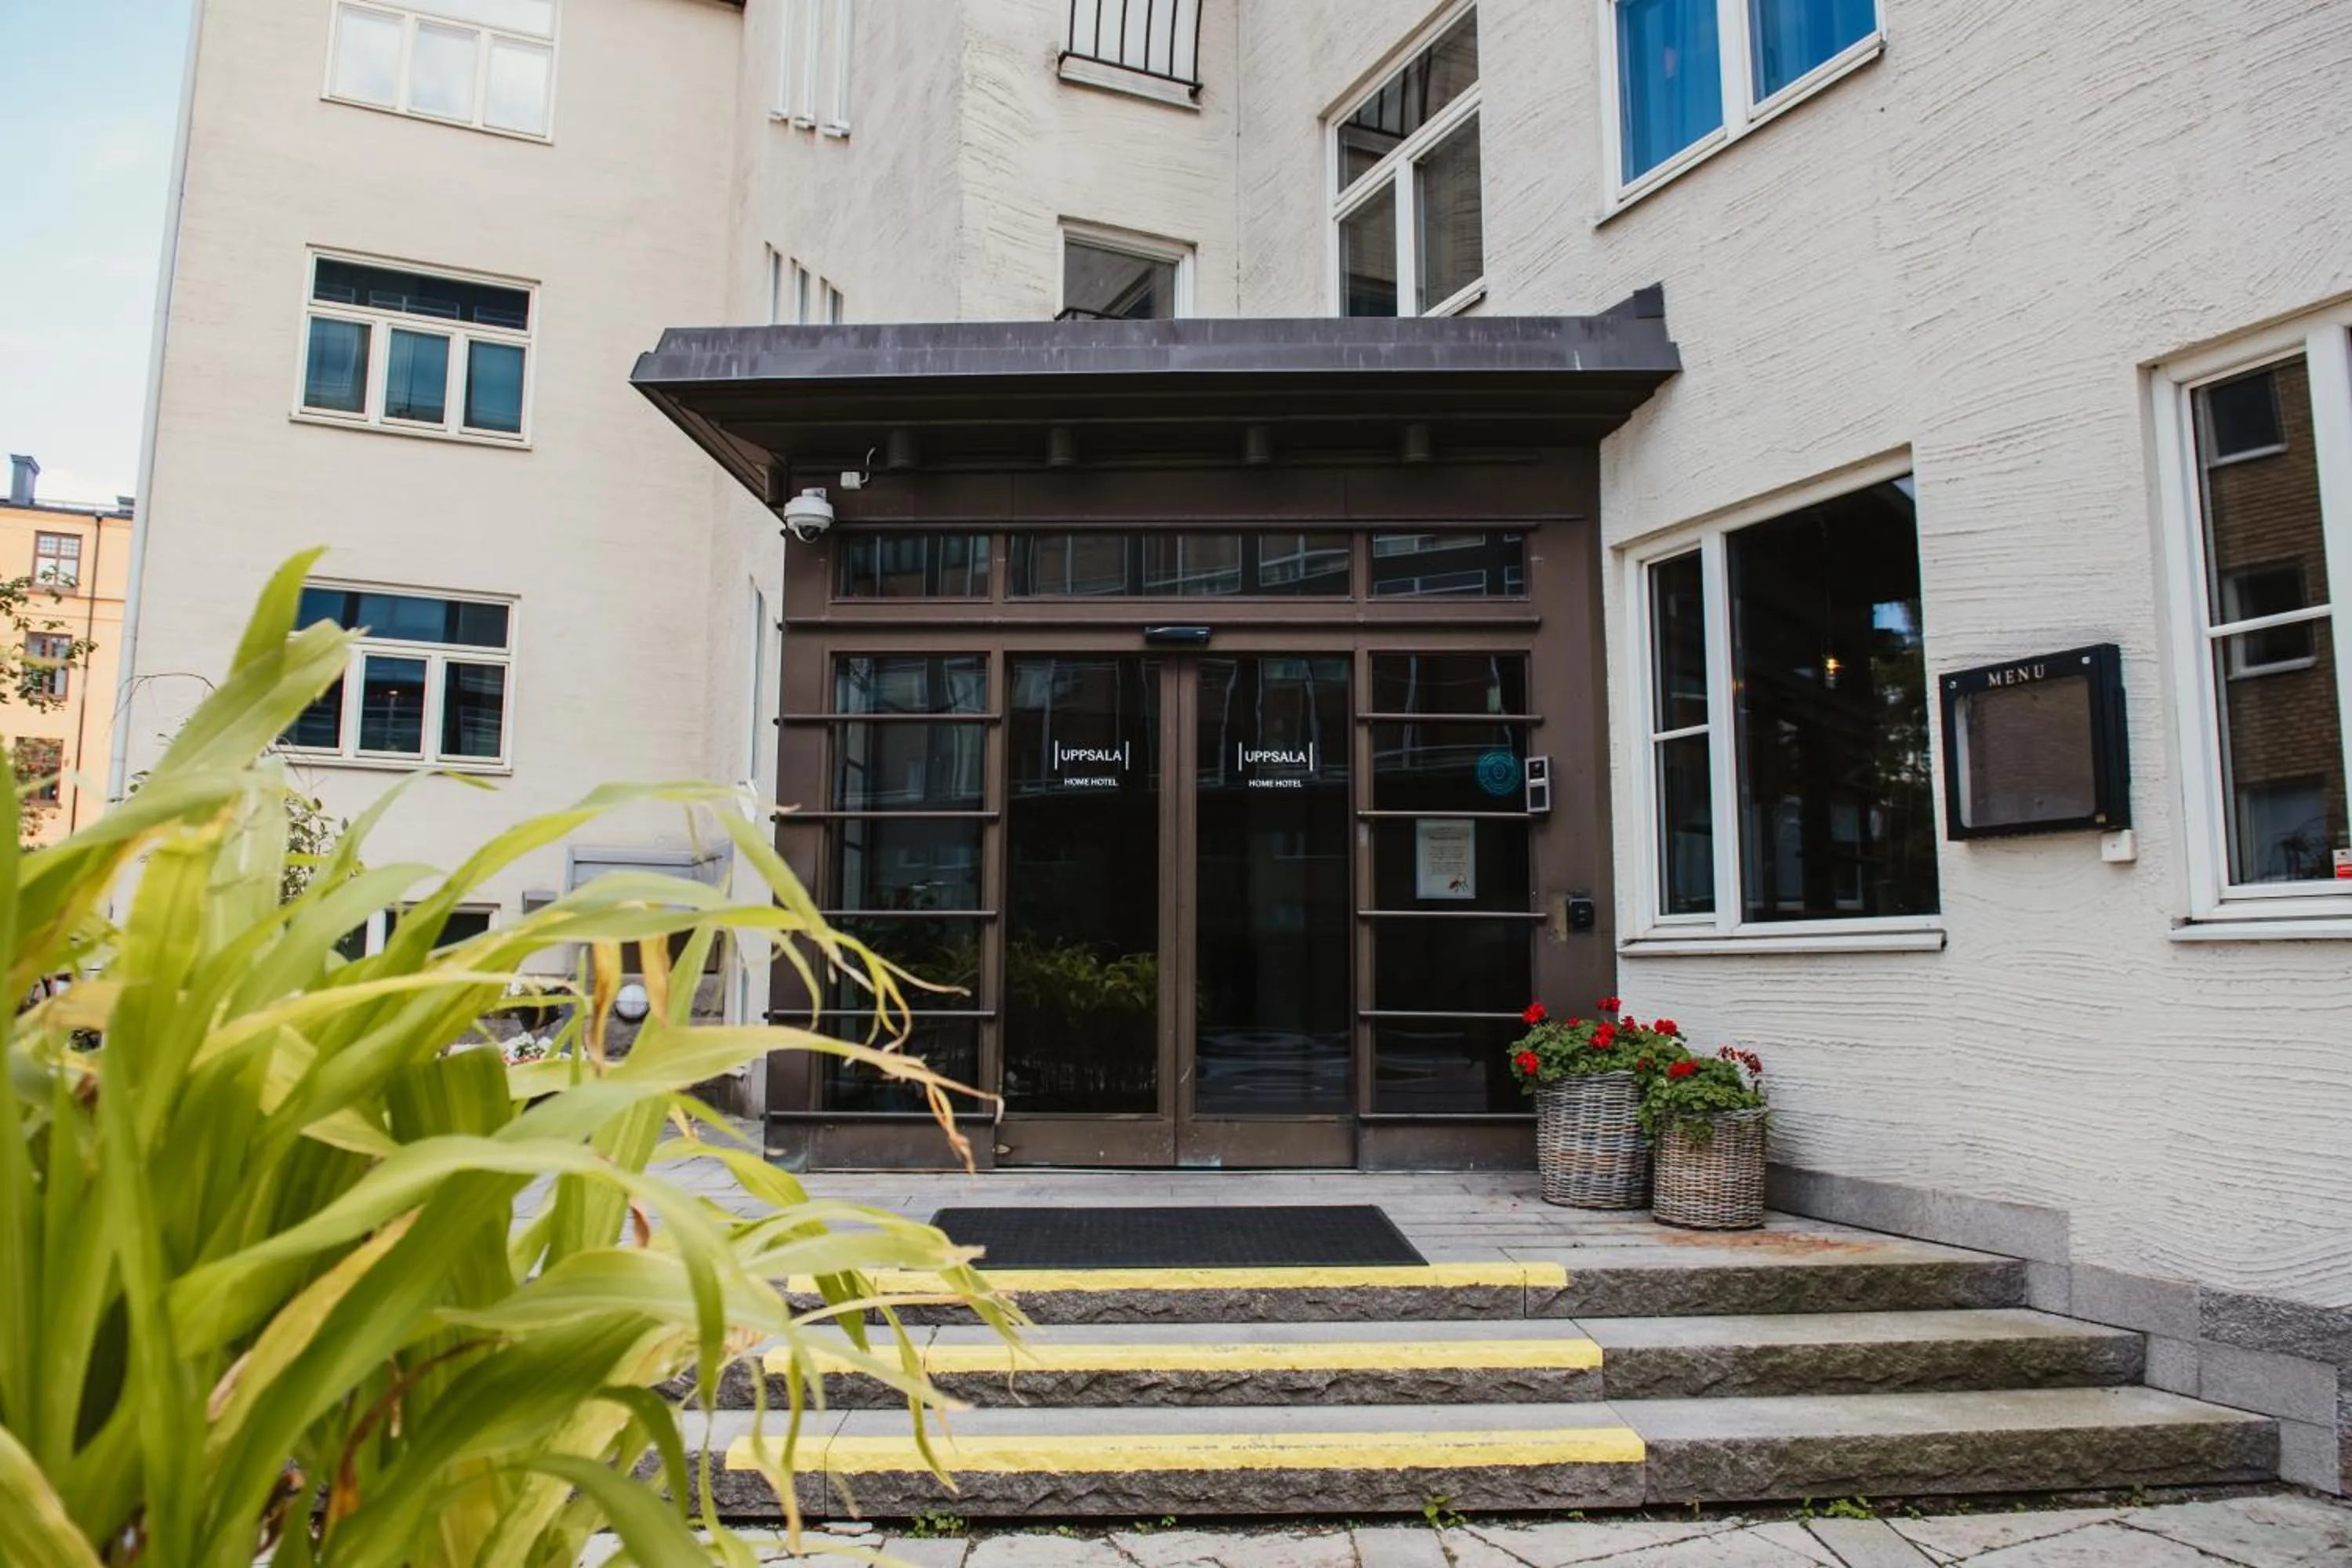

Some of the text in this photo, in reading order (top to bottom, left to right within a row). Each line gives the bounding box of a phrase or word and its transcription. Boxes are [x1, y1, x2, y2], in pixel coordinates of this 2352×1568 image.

[1988, 664, 2045, 688] MENU
[1061, 749, 1122, 761] UPPSALA
[1244, 750, 1307, 763] UPPSALA
[1064, 777, 1118, 786] HOME HOTEL
[1248, 779, 1302, 788] HOME HOTEL
